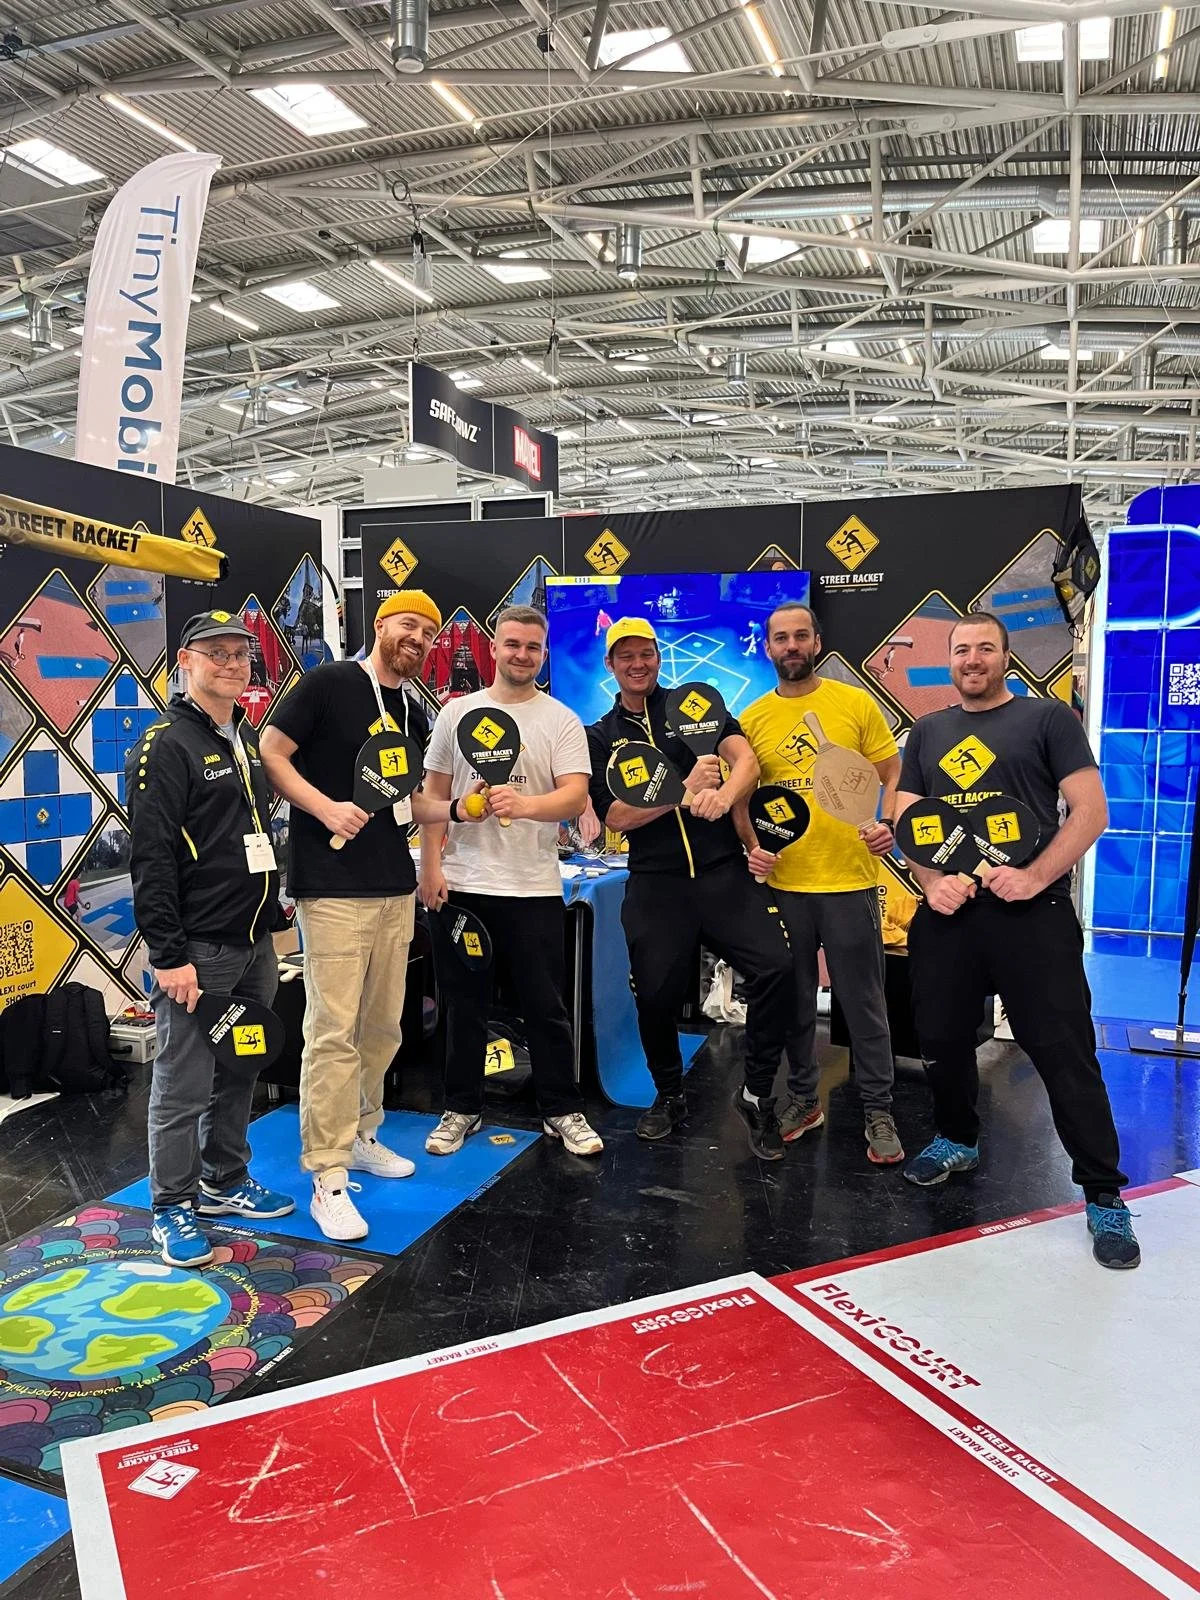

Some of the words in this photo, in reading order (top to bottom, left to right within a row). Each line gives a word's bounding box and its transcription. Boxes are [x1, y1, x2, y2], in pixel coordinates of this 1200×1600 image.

[72, 521, 141, 553] RACKET
[820, 574, 851, 585] STREET
[852, 572, 885, 584] RACKET
[17, 979, 37, 991] court
[464, 1341, 499, 1356] STREET
[426, 1351, 462, 1365] RACKET
[947, 1427, 985, 1452] RACKET
[160, 1443, 200, 1459] STREET
[972, 1424, 1016, 1454] STREET
[1011, 1453, 1059, 1483] RACKET
[117, 1453, 158, 1470] RACKET
[981, 1452, 1020, 1478] STREET
